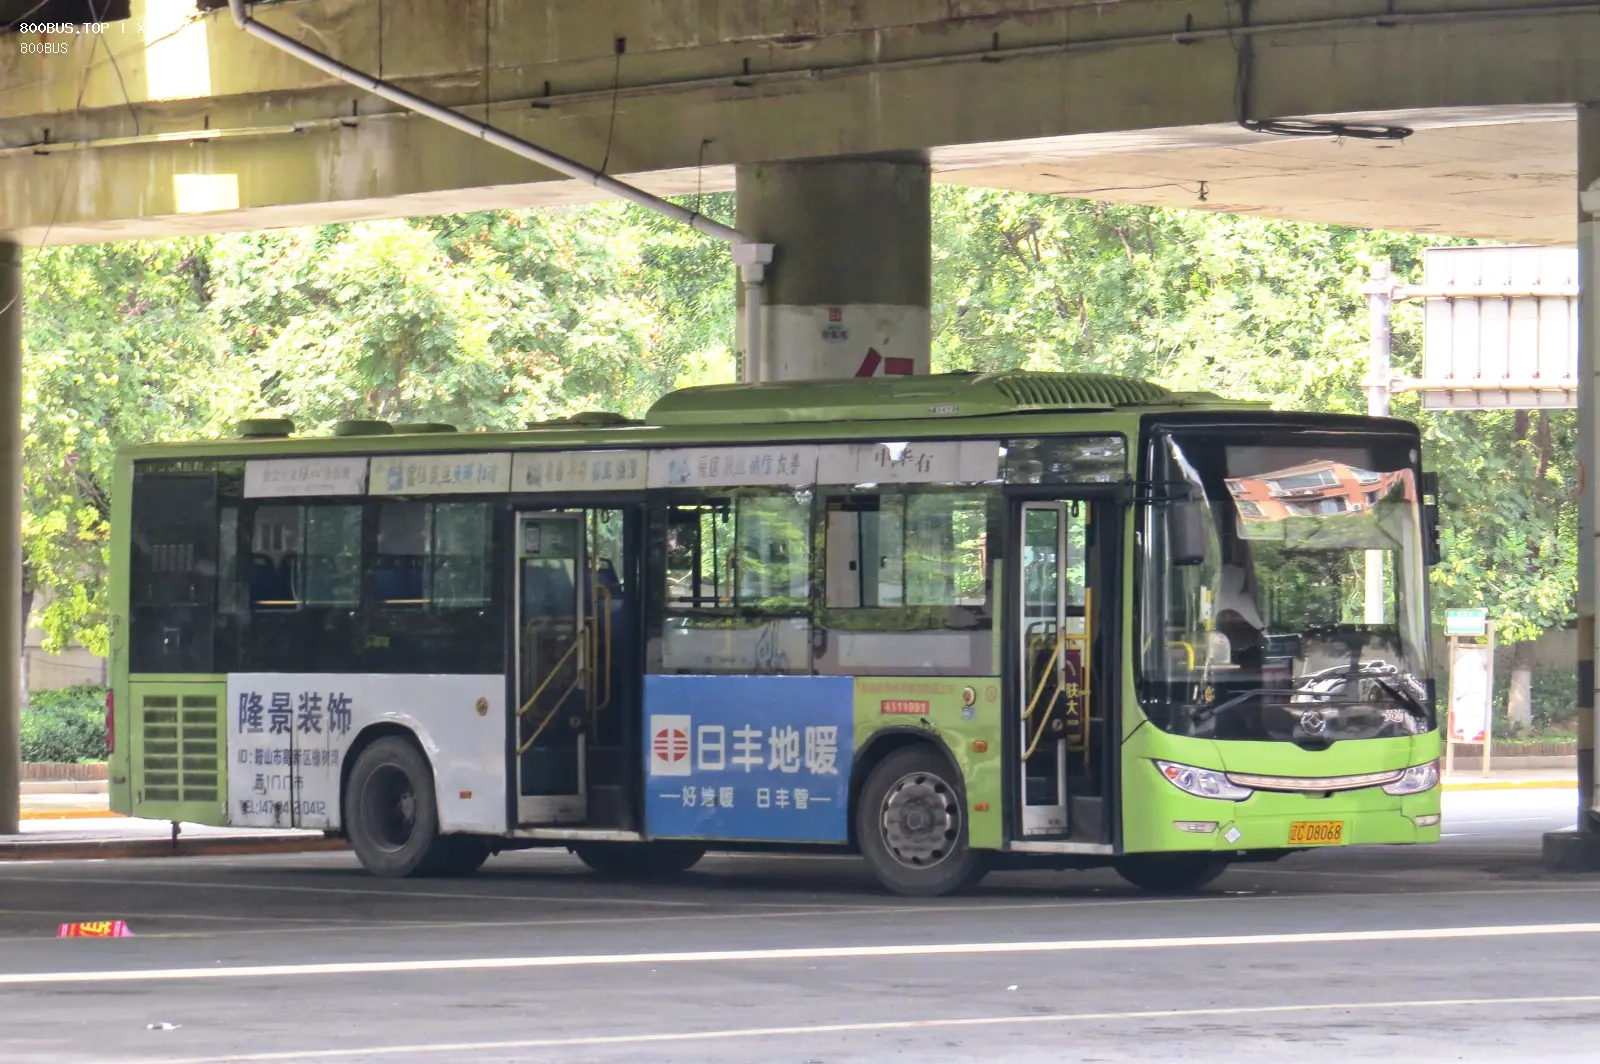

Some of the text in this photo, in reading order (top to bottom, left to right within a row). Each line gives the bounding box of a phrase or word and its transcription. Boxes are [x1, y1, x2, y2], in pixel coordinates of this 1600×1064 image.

[237, 691, 353, 735] 隆景装饰
[697, 723, 839, 776] 日丰地暖
[682, 785, 735, 808] 好地暖
